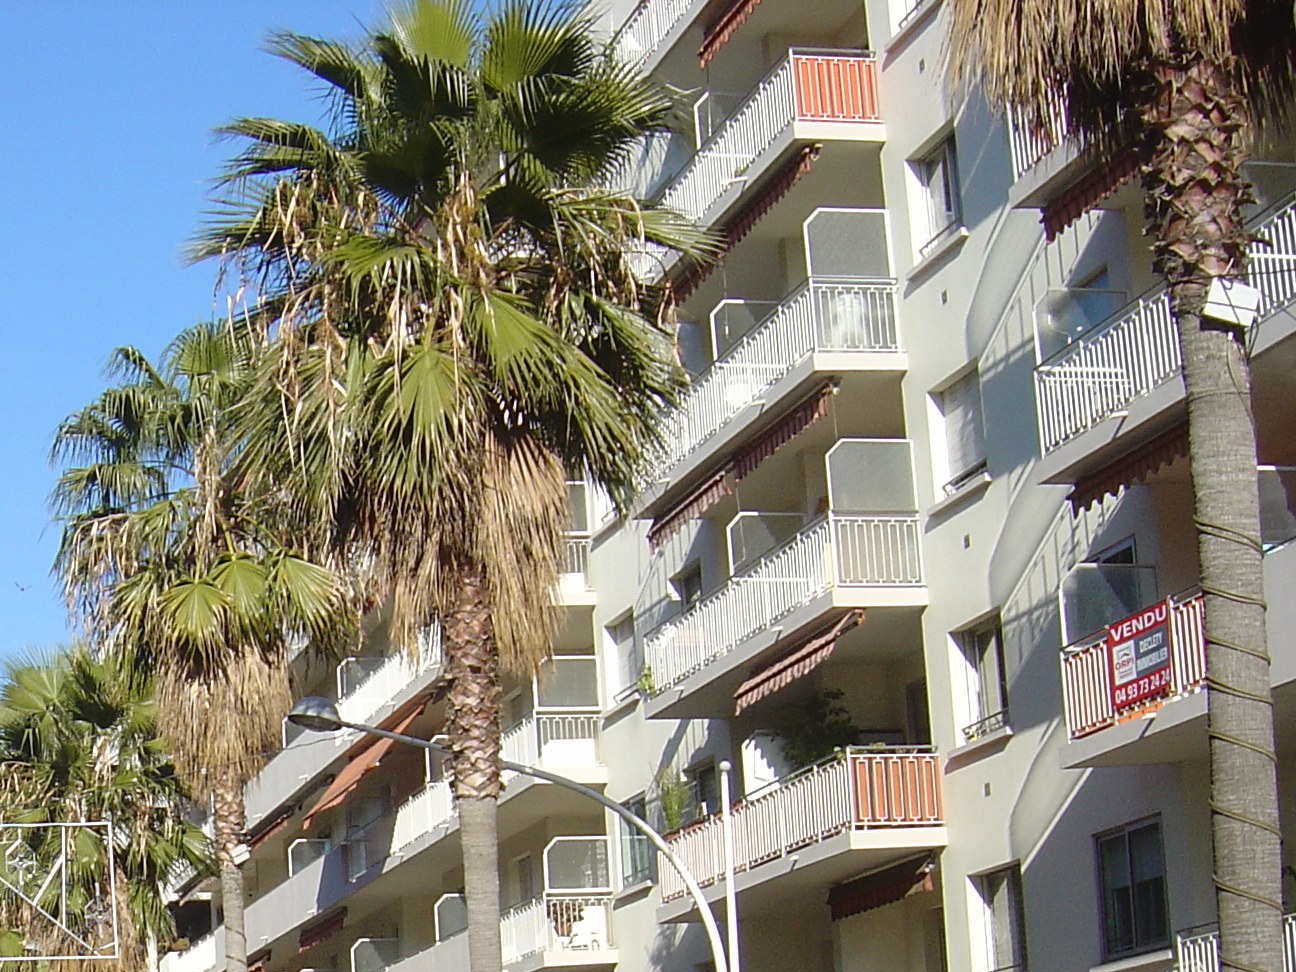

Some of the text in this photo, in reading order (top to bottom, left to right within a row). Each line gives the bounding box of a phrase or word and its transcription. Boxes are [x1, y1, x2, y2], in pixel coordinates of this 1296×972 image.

[1110, 605, 1167, 641] VENDU
[1115, 687, 1126, 704] 04
[1127, 682, 1138, 700] 93
[1138, 678, 1149, 695] 73
[1150, 672, 1160, 690] 24
[1161, 667, 1170, 685] 24
